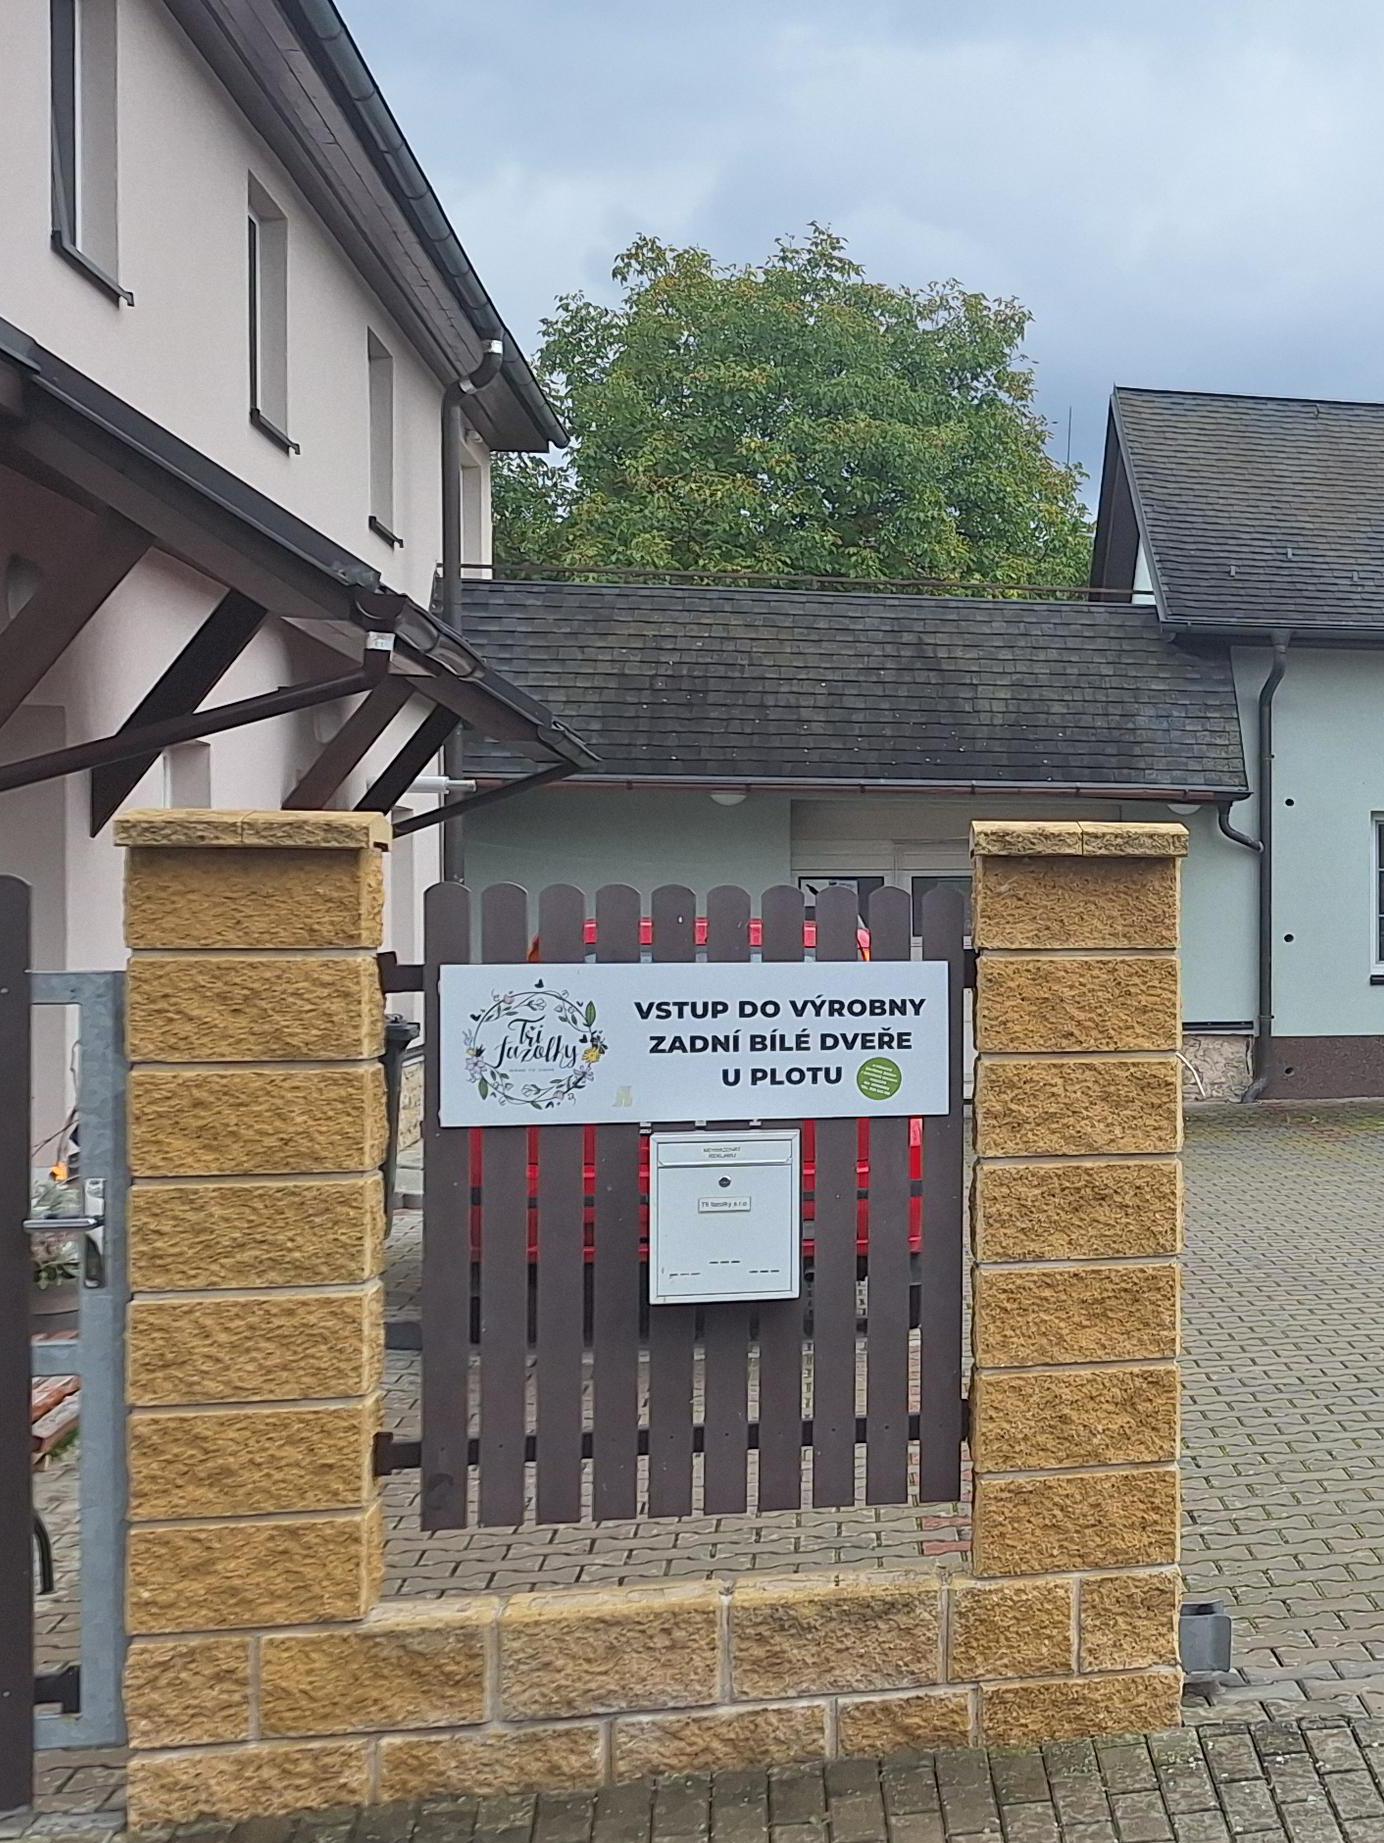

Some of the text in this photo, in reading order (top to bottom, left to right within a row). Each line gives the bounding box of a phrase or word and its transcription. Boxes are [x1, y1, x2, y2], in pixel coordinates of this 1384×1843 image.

[634, 994, 927, 1020] VSTUP DO VÝROBNY
[508, 1014, 546, 1047] Tři
[649, 1027, 912, 1054] ZADNÍ BÍLÉ DVEŘE
[722, 1068, 741, 1087] U
[750, 1066, 843, 1086] PLOTU
